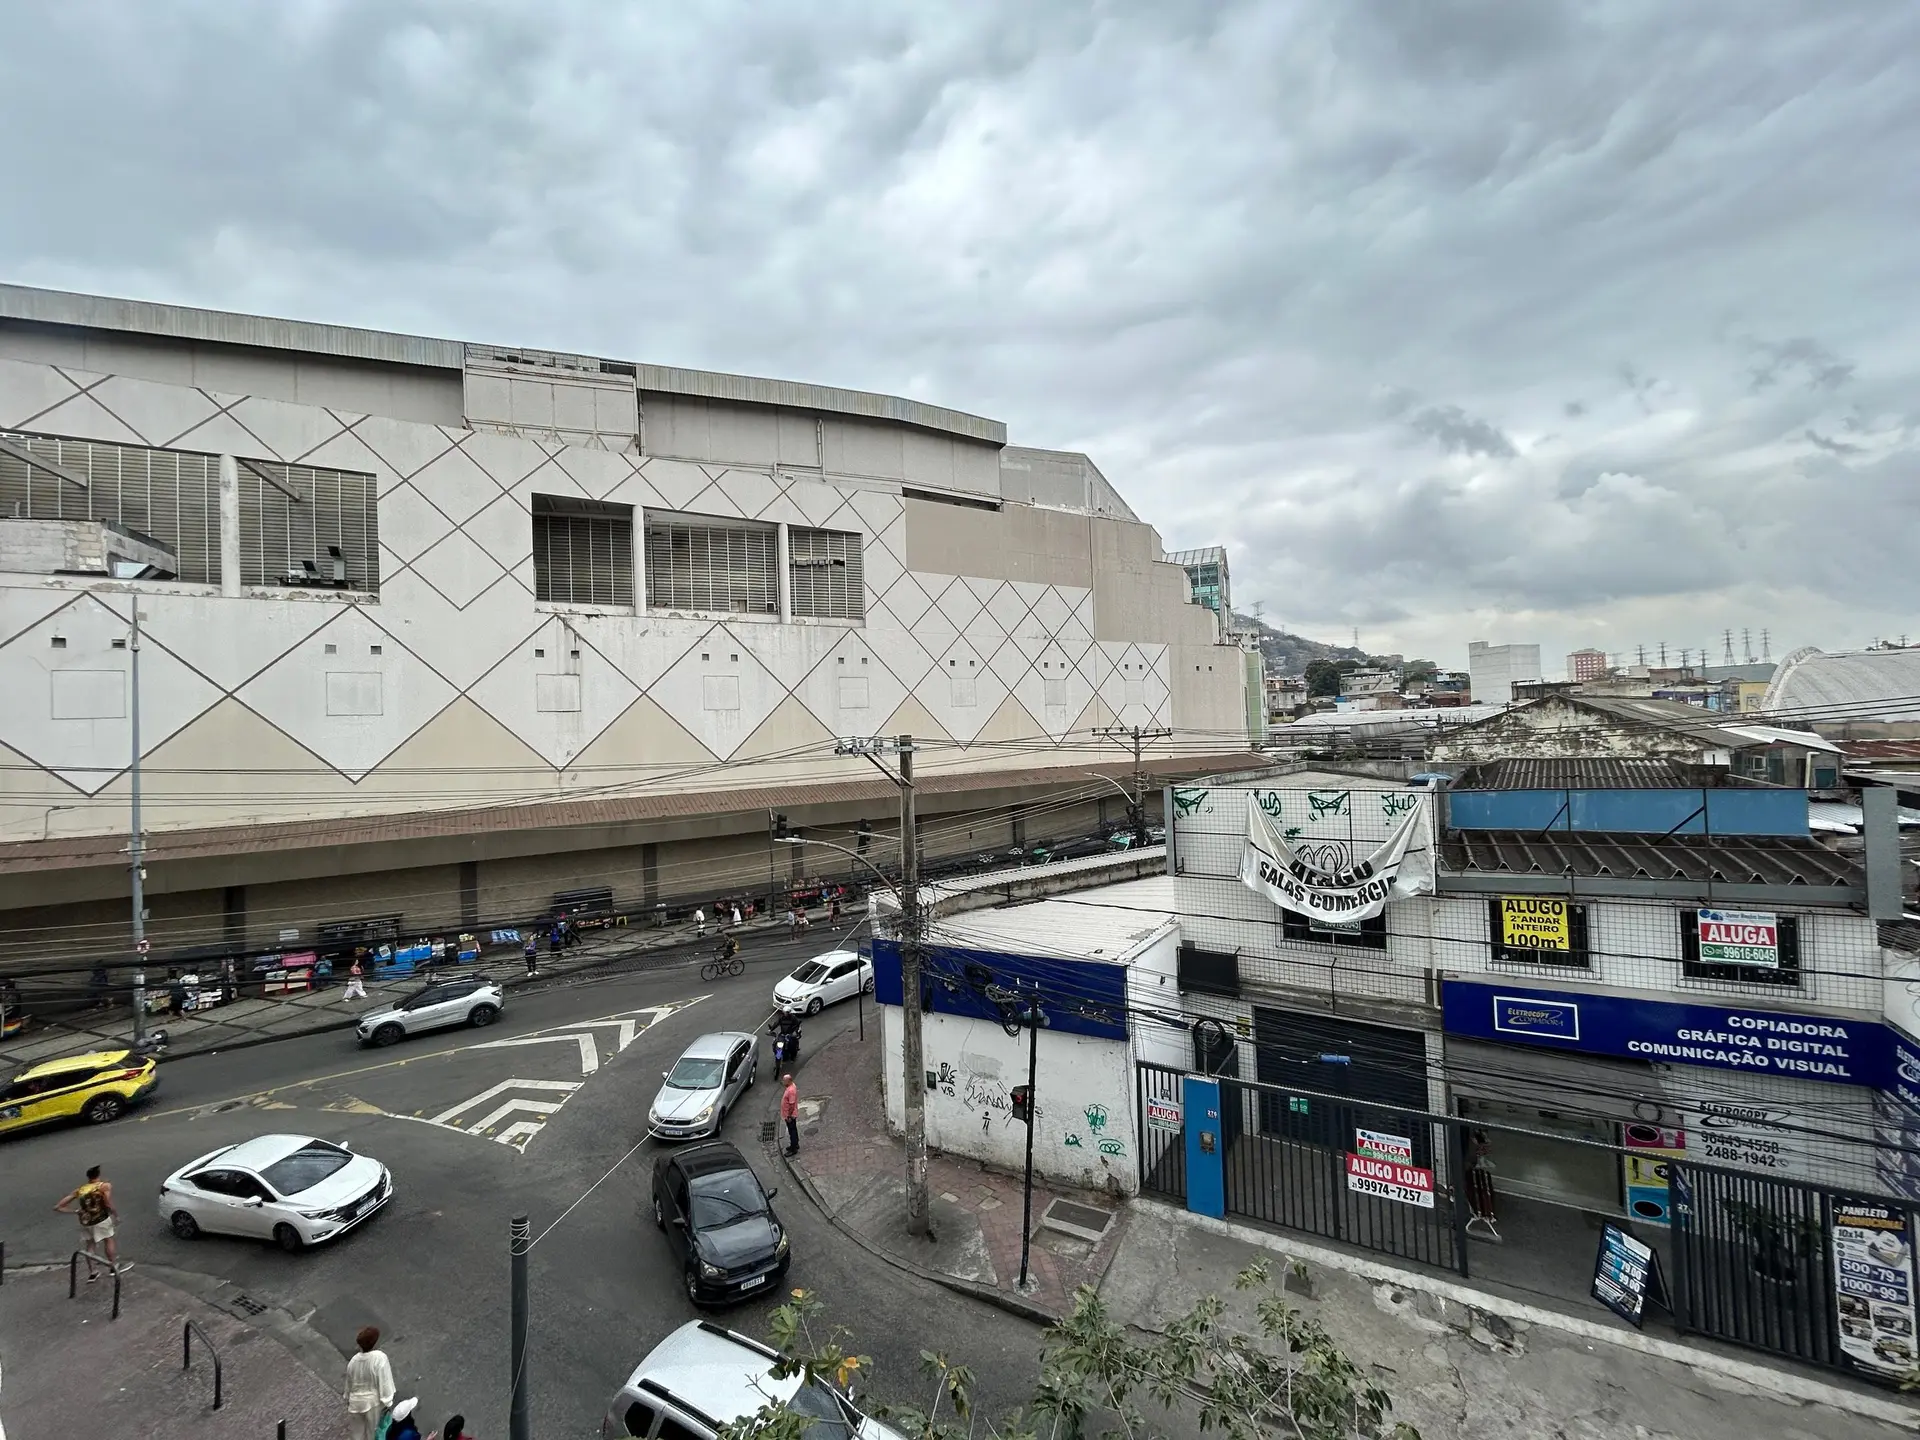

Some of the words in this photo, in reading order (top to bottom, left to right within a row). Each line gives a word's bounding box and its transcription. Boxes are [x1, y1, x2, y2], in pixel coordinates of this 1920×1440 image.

[1259, 861, 1306, 902] SALAS
[1505, 900, 1563, 915] ALUGO
[1512, 923, 1559, 932] INTEIRO
[1708, 924, 1771, 945] ALUGA
[1723, 946, 1776, 961] 99616-6045
[1508, 1007, 1550, 1019] ELETROCOPY
[1727, 1016, 1849, 1039] COPIADORA
[1677, 1029, 1762, 1048] GRÁFICA
[1767, 1038, 1849, 1058] DIGITAL
[1628, 1040, 1769, 1066] COMUNICAÇÃO
[1774, 1057, 1851, 1077] VISUAL
[1151, 1107, 1178, 1121] ALUGA
[1700, 1101, 1768, 1120] ELETROCOPY
[1363, 1141, 1407, 1157] ALUGA
[1705, 1145, 1777, 1167] 2488-1942
[1351, 1158, 1393, 1180] ALUGO
[1396, 1167, 1428, 1188] LOJA
[1357, 1178, 1422, 1203] 99974-7257
[1842, 1205, 1889, 1219] PANFLETO
[1838, 1228, 1864, 1239] 10x14
[1841, 1260, 1870, 1275] 500
[1841, 1277, 1873, 1293] 1000
